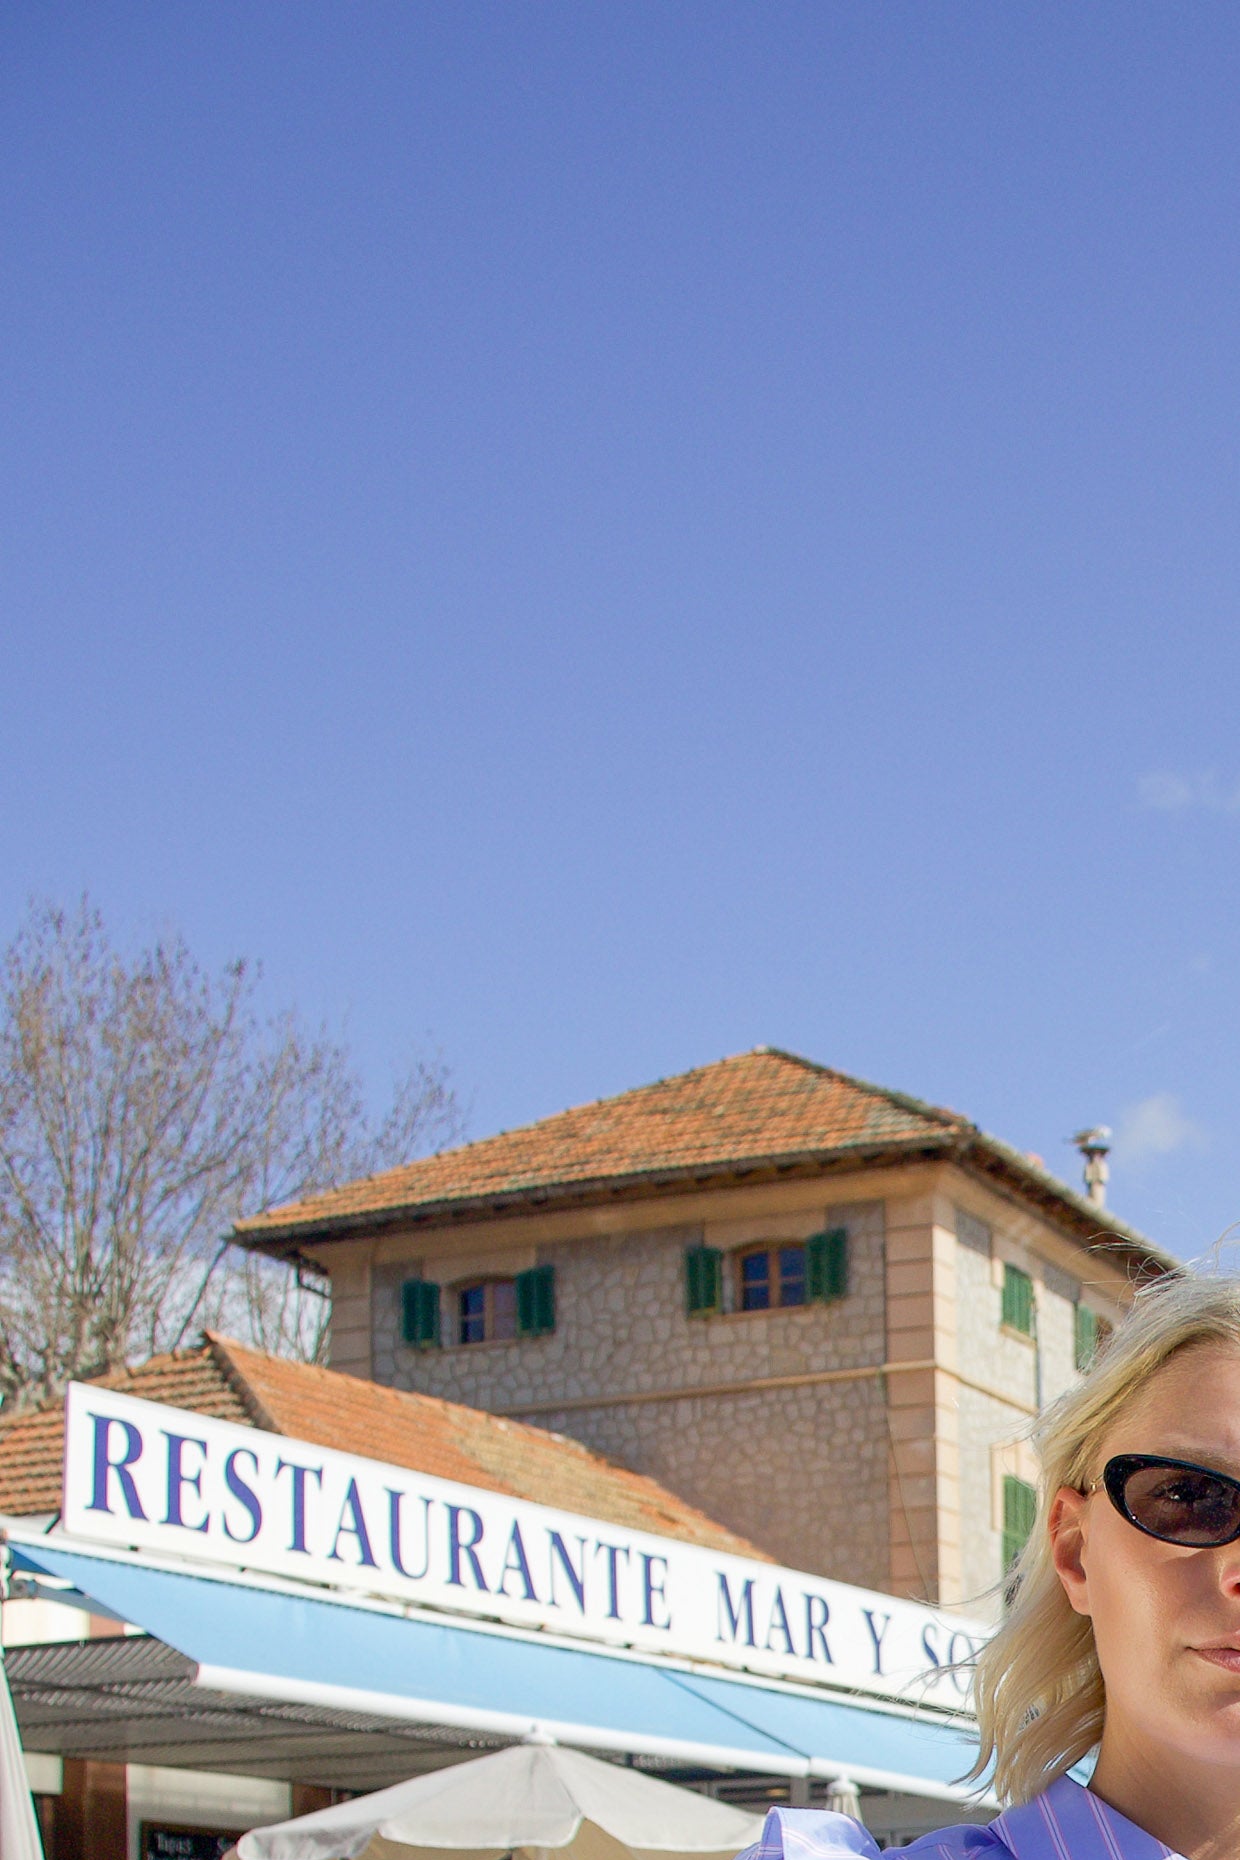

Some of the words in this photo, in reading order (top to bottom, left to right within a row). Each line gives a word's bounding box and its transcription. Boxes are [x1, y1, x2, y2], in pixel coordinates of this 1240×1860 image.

[84, 1410, 671, 1632] RESTAURANTE
[713, 1570, 838, 1667] MAR
[859, 1604, 893, 1678] Y
[920, 1622, 982, 1697] SO
